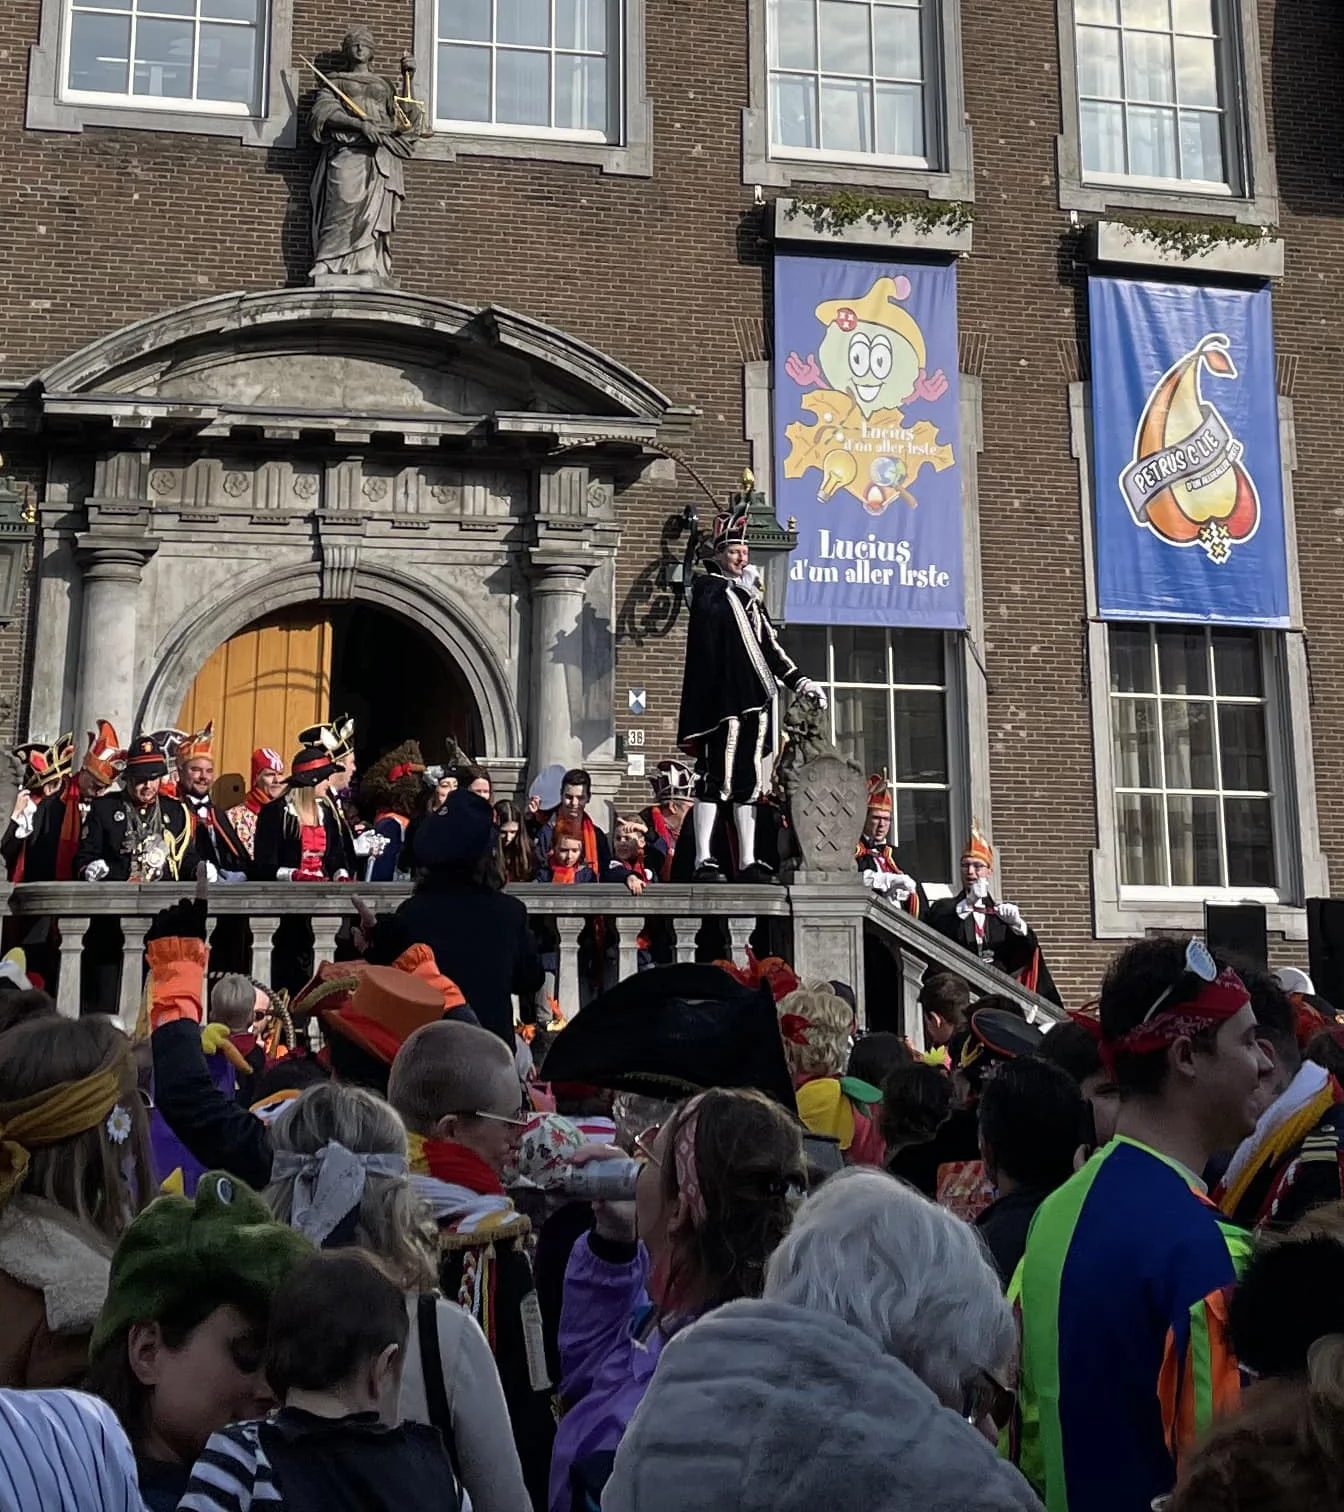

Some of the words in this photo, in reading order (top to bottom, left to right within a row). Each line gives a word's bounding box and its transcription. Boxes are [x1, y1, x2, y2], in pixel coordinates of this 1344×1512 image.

[1133, 449, 1187, 495] PETRUS
[1196, 429, 1219, 458] LIE
[818, 529, 911, 564] Lucius
[789, 558, 839, 583] d'un
[845, 559, 894, 586] aller
